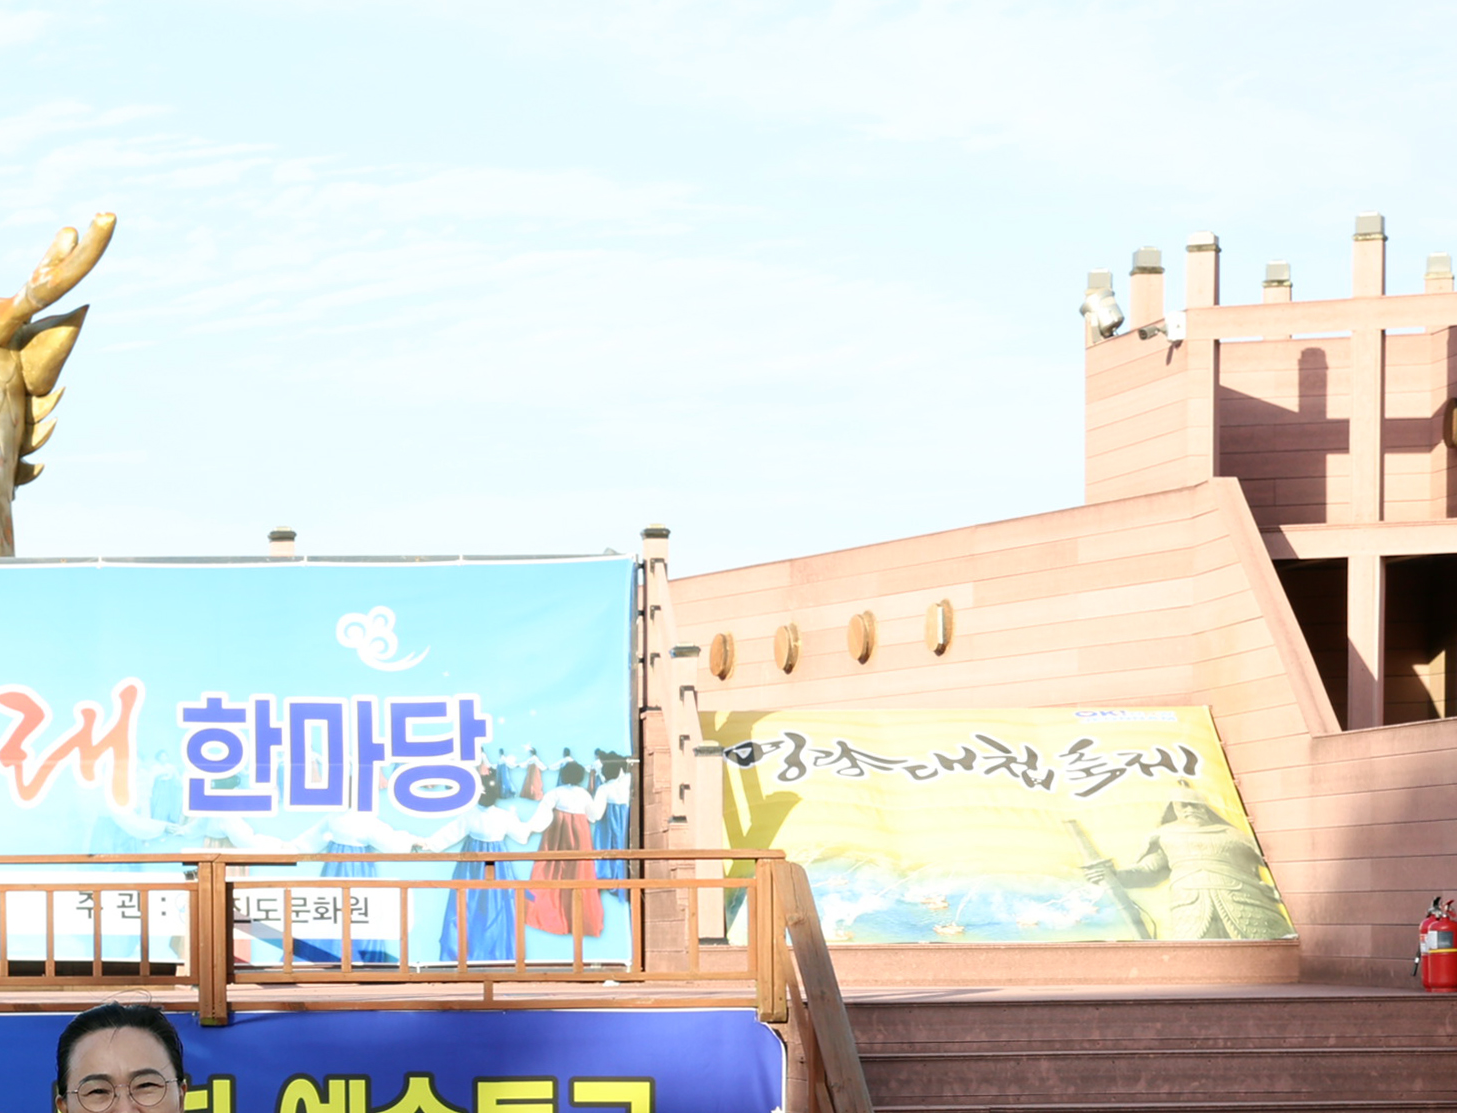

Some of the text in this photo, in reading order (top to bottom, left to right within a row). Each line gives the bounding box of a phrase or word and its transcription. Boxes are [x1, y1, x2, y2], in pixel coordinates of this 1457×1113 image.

[181, 695, 488, 813] 한마당
[723, 731, 1199, 798] 명량대첩축제
[232, 896, 370, 924] 진도문화원
